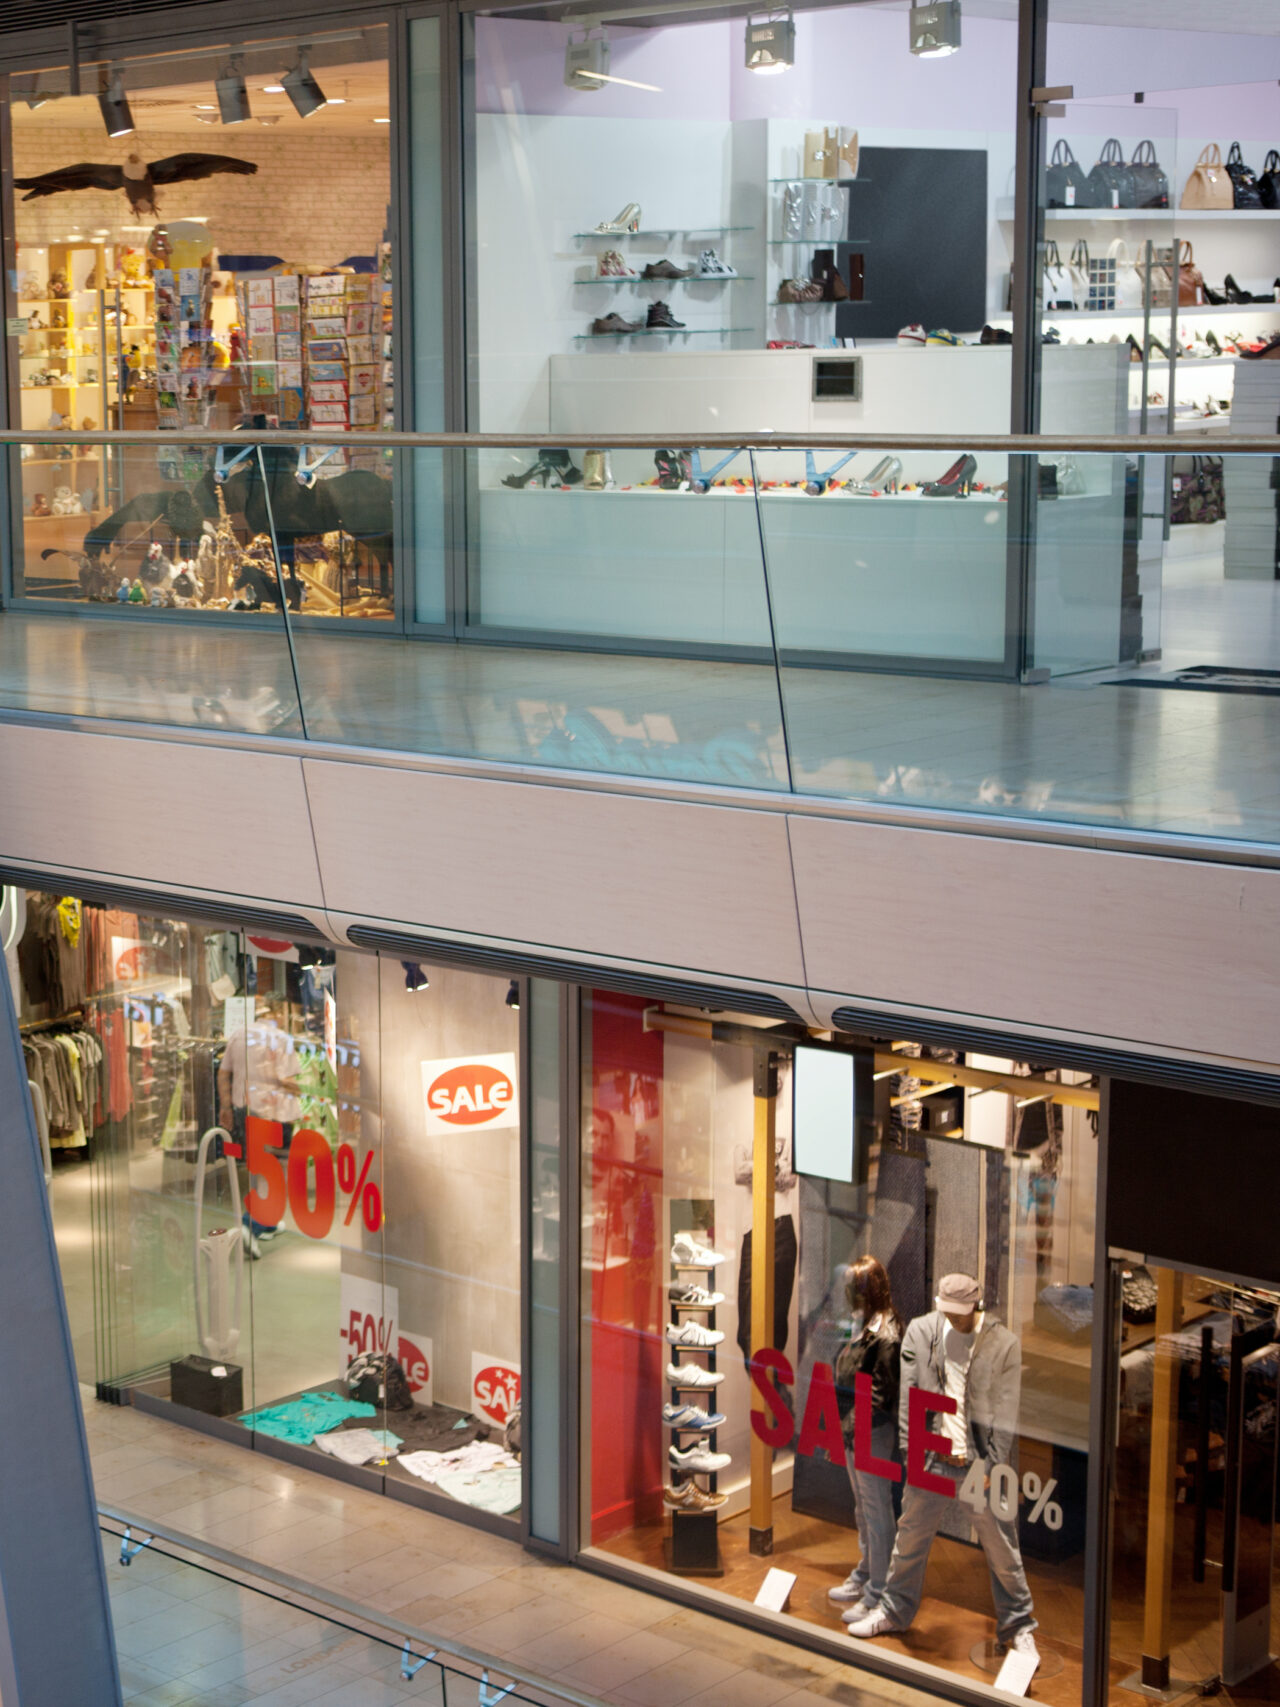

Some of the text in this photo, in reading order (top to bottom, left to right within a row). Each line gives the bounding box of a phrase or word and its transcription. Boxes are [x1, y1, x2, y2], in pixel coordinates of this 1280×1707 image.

[431, 1081, 510, 1116] SALE
[223, 1115, 383, 1240] -50%
[750, 1347, 958, 1499] SALE
[958, 1458, 1064, 1531] 40%
